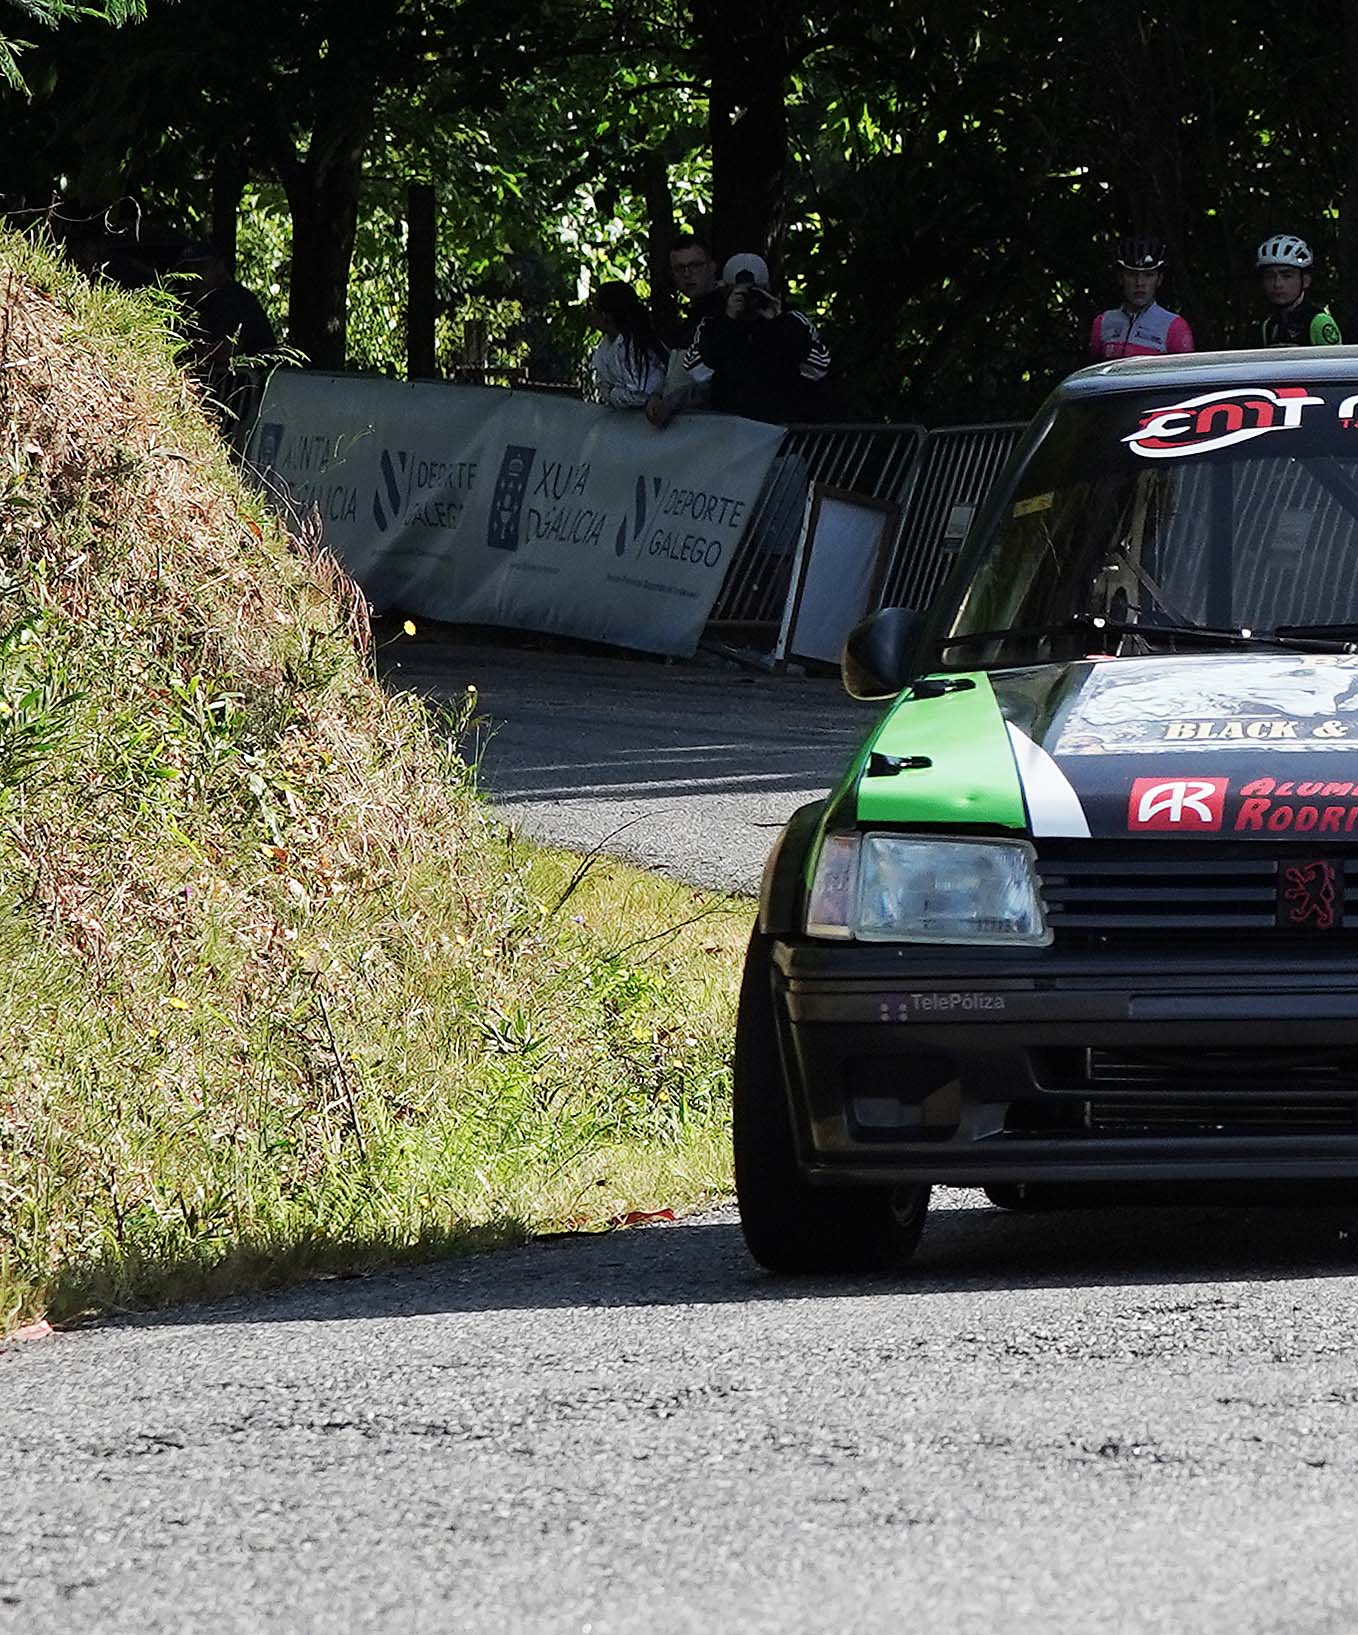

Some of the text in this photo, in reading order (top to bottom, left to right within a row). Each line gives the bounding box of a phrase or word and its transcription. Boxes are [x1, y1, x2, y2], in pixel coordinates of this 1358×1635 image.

[664, 488, 745, 528] DEPORTE
[649, 528, 722, 568] GALEGO
[1164, 720, 1298, 739] BLACK
[1312, 720, 1348, 738] &
[1137, 780, 1215, 823] AR
[910, 993, 1006, 1010] TelePóliza
